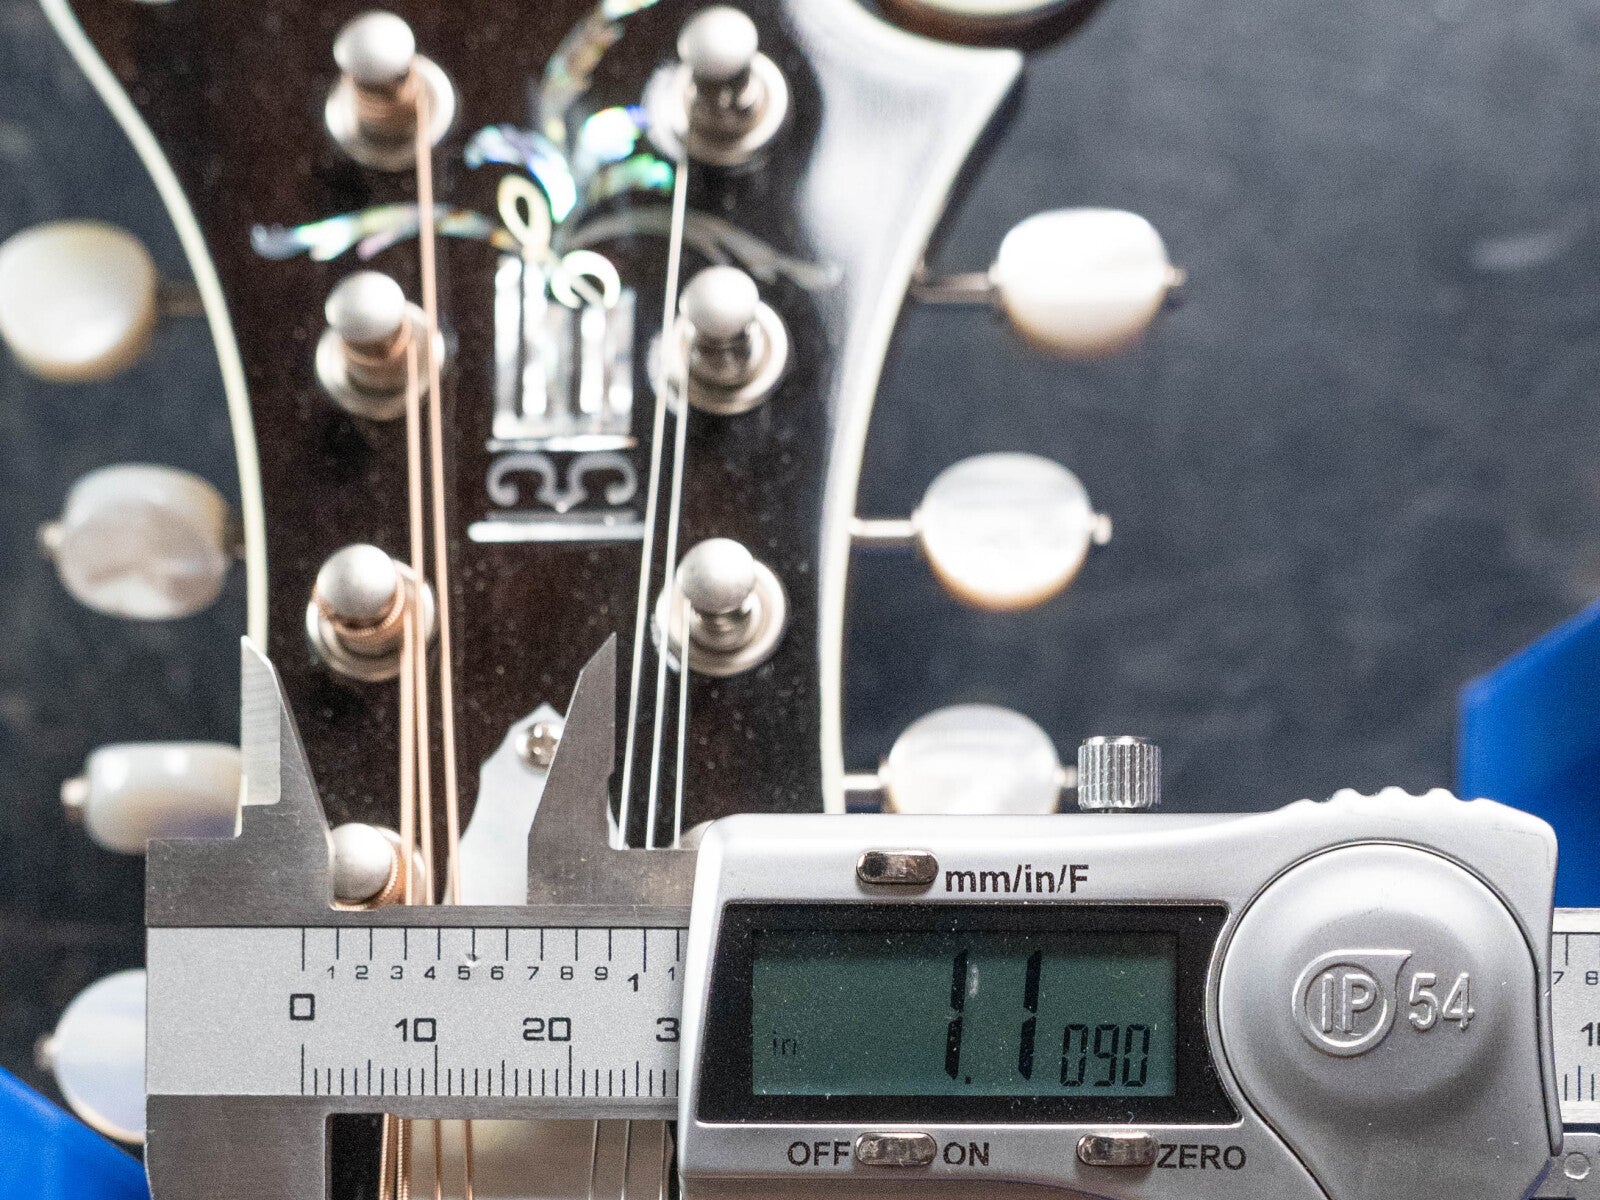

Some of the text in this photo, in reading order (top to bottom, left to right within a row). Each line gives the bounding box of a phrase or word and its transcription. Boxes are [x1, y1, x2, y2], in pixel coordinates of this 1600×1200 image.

[945, 863, 1090, 895] mm/in/F
[326, 965, 336, 980] 1
[355, 965, 369, 980] 2
[390, 965, 404, 980] 3
[423, 965, 436, 980] 4
[457, 965, 471, 981] 5
[490, 965, 504, 981] 6
[526, 965, 539, 981] 7
[560, 965, 574, 981] 8
[594, 966, 608, 981] 9
[627, 973, 639, 992] 1
[1552, 970, 1599, 985] 7 8
[289, 993, 680, 1042] 0 10 20 3
[1321, 972, 1476, 1034] IP 54
[771, 1030, 797, 1056] in
[1580, 1021, 1600, 1047] 1
[786, 1140, 1247, 1171] OFF ON ZERO
